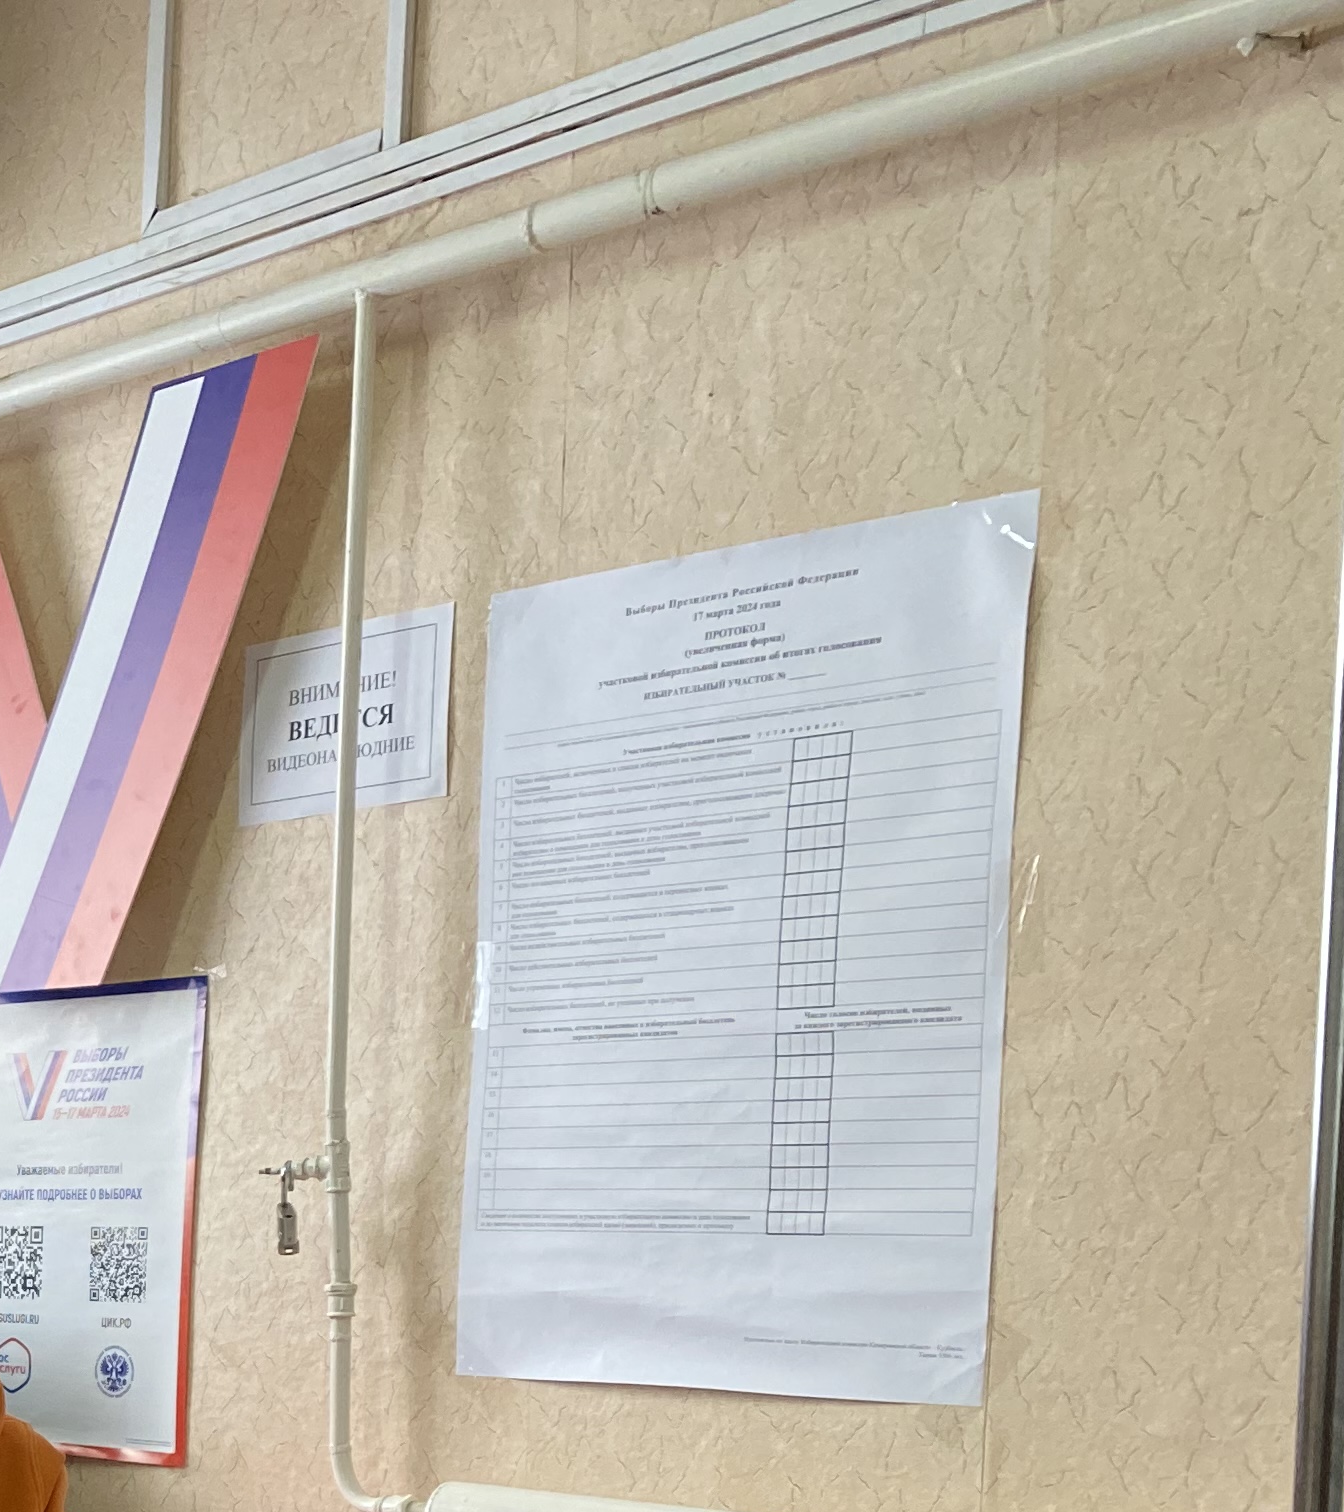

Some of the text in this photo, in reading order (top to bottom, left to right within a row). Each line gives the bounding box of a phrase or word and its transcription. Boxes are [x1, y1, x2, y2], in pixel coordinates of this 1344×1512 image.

[625, 568, 859, 617] Выборы Президента Российской Федерации
[692, 610, 704, 622] 17
[705, 606, 734, 621] марта
[704, 622, 766, 640] ПРОТОКОЛ
[288, 671, 397, 706] ВНИМНИЕ!
[643, 680, 725, 700] ИЗБИРАТЕЛЬНЫЙ
[728, 673, 774, 688] УЧАСТОК
[288, 703, 394, 742] ВЕДСЯ
[267, 735, 415, 773] ВИДЕОНАЮДНИЕ
[72, 1046, 129, 1063] ВЫБОРЫ
[64, 1064, 144, 1083] ПРЕЗИДЕНТА
[56, 1086, 108, 1103] РОССИИ
[76, 1105, 108, 1119] МАРТА
[108, 1105, 131, 1119] 2024
[16, 1162, 123, 1176] Уважаемые избиратели!
[36, 1188, 88, 1202] ПОДРОБНЕЕ
[90, 1188, 97, 1200] О
[98, 1187, 143, 1200] ВЫБОРАХ
[101, 1317, 132, 1329] ЦИК.РФ
